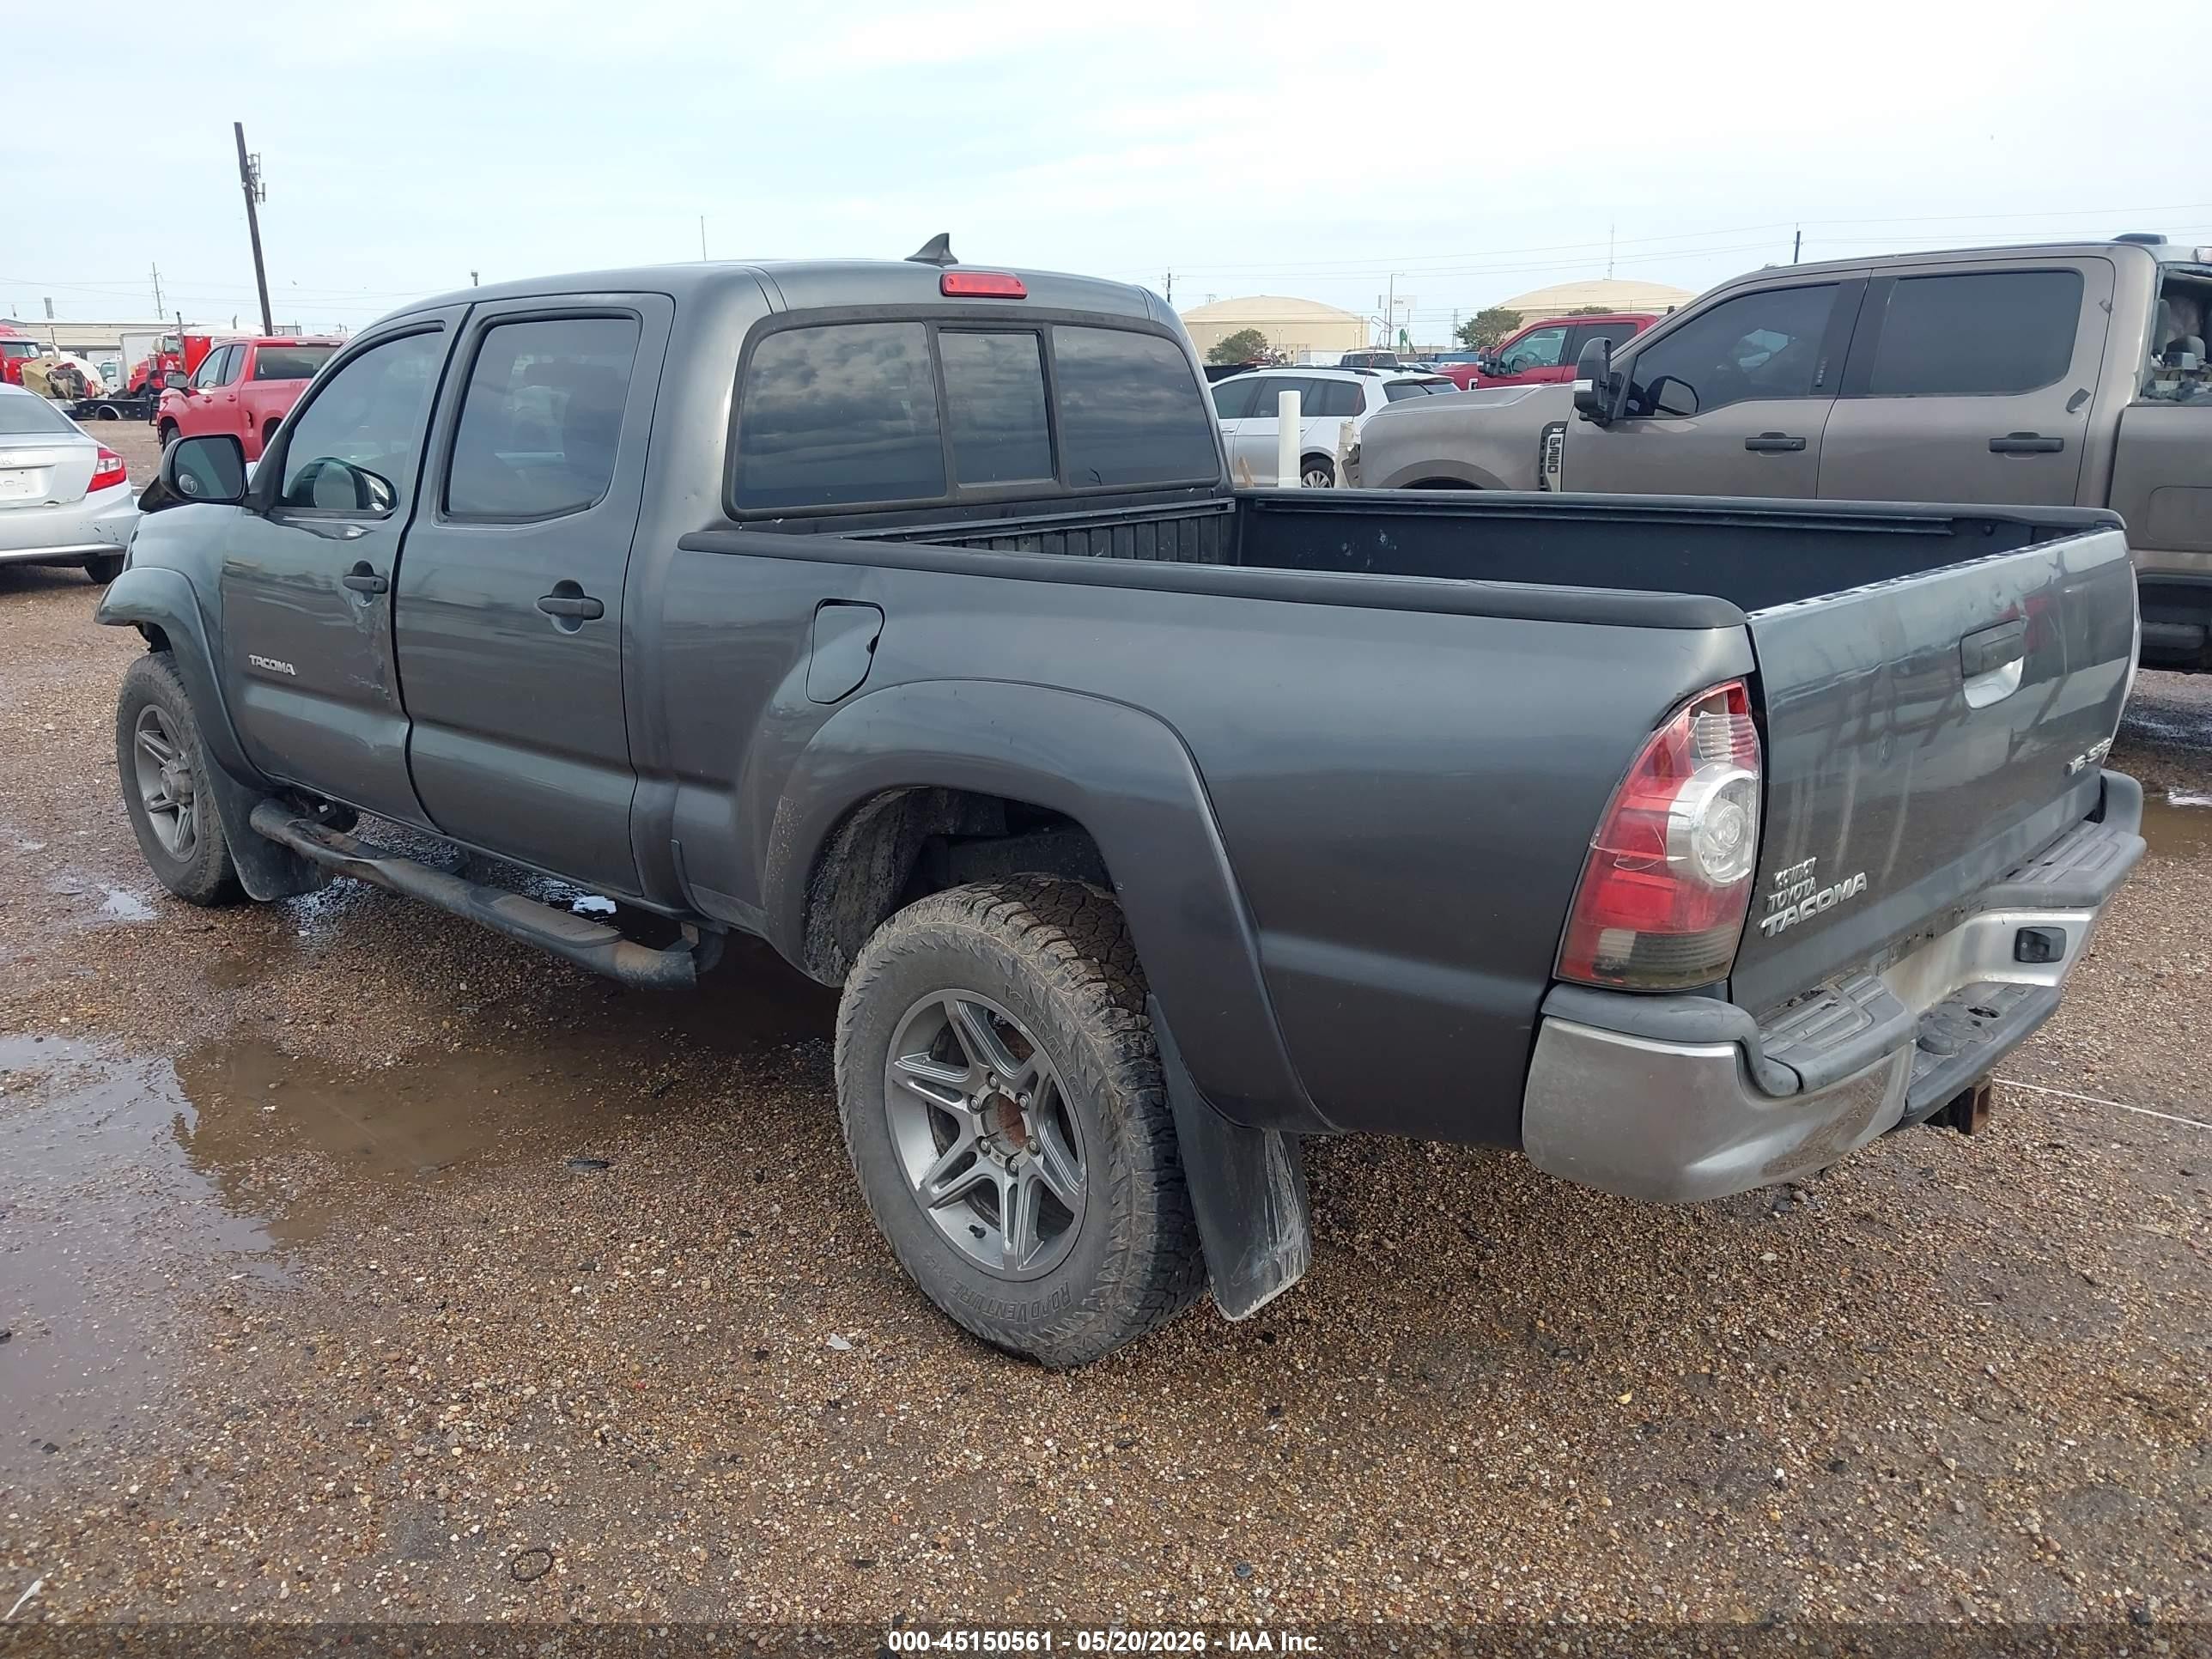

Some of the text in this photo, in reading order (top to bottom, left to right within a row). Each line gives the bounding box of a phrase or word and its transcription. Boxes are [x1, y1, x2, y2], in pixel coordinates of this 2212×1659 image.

[248, 653, 296, 676] TACOMA
[1759, 872, 1868, 938] TACOMA
[1766, 876, 1817, 913] TOYOTA
[1005, 982, 1085, 1104] KUMHO
